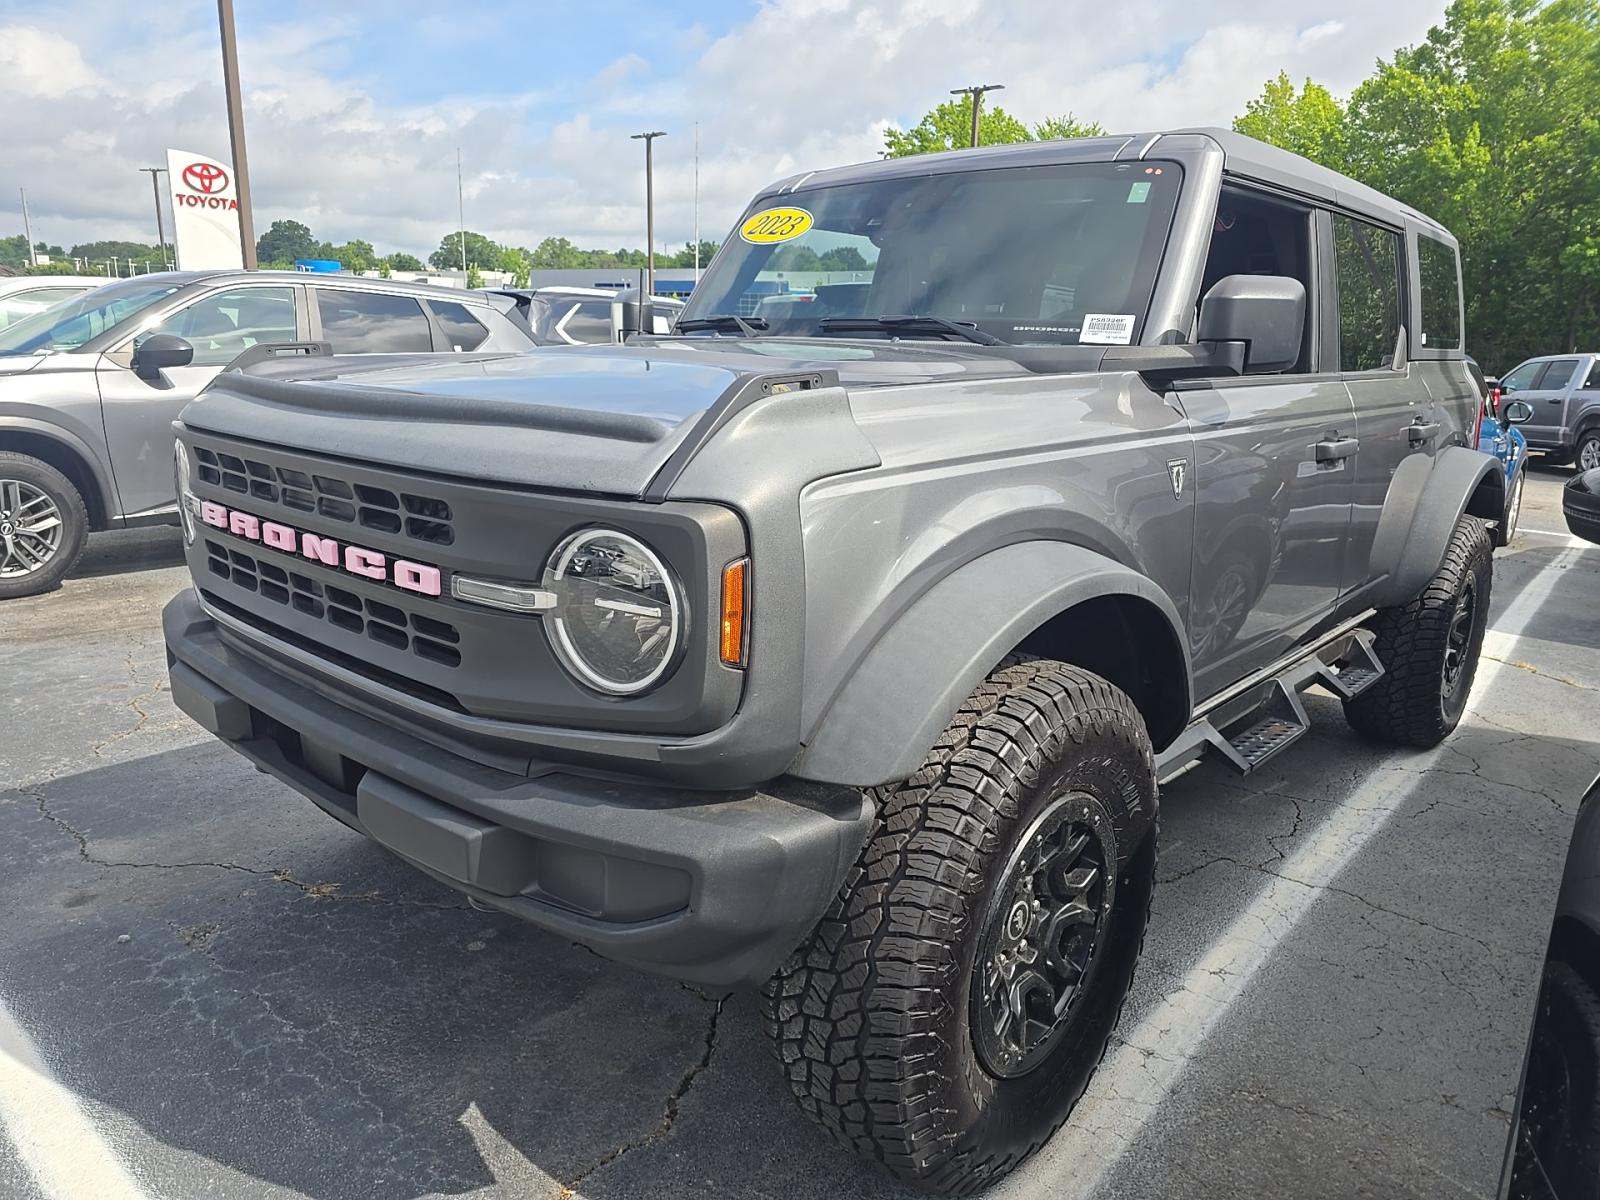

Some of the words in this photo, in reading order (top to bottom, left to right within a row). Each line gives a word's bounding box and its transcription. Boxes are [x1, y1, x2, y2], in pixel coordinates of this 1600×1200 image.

[175, 193, 238, 211] TOYOTA
[747, 215, 805, 236] 2023
[201, 500, 442, 597] BRONCO
